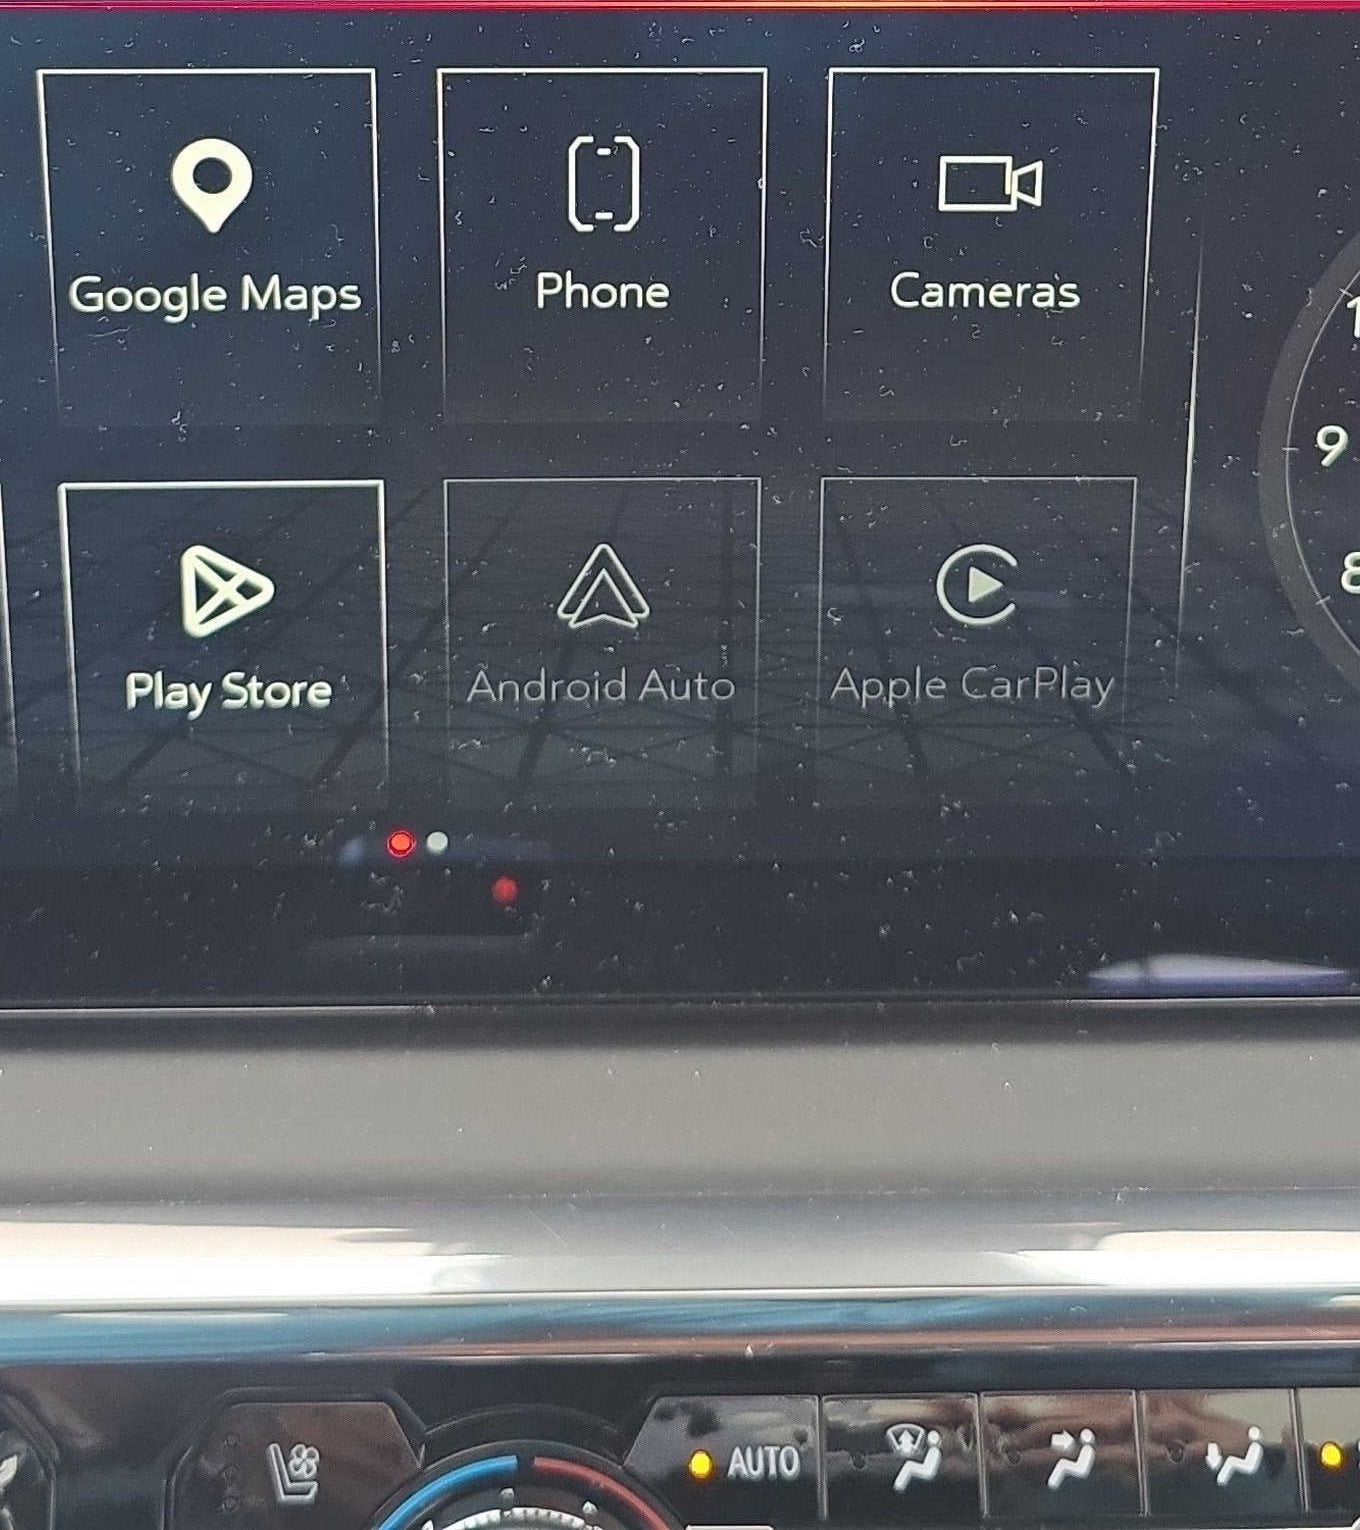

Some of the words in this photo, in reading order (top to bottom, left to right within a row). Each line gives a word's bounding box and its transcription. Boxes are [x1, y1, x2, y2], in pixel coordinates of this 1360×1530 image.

[67, 271, 229, 325] Google
[240, 273, 363, 323] Maps
[536, 269, 671, 310] Phone
[890, 270, 1082, 310] Cameras
[1315, 424, 1349, 468] 9
[125, 669, 211, 721] Play
[221, 670, 333, 710] Store
[465, 666, 627, 704] Android
[637, 667, 737, 702] Auto
[829, 664, 947, 710] Apple
[960, 663, 1116, 711] CarPlay
[727, 1444, 801, 1478] AUTO
